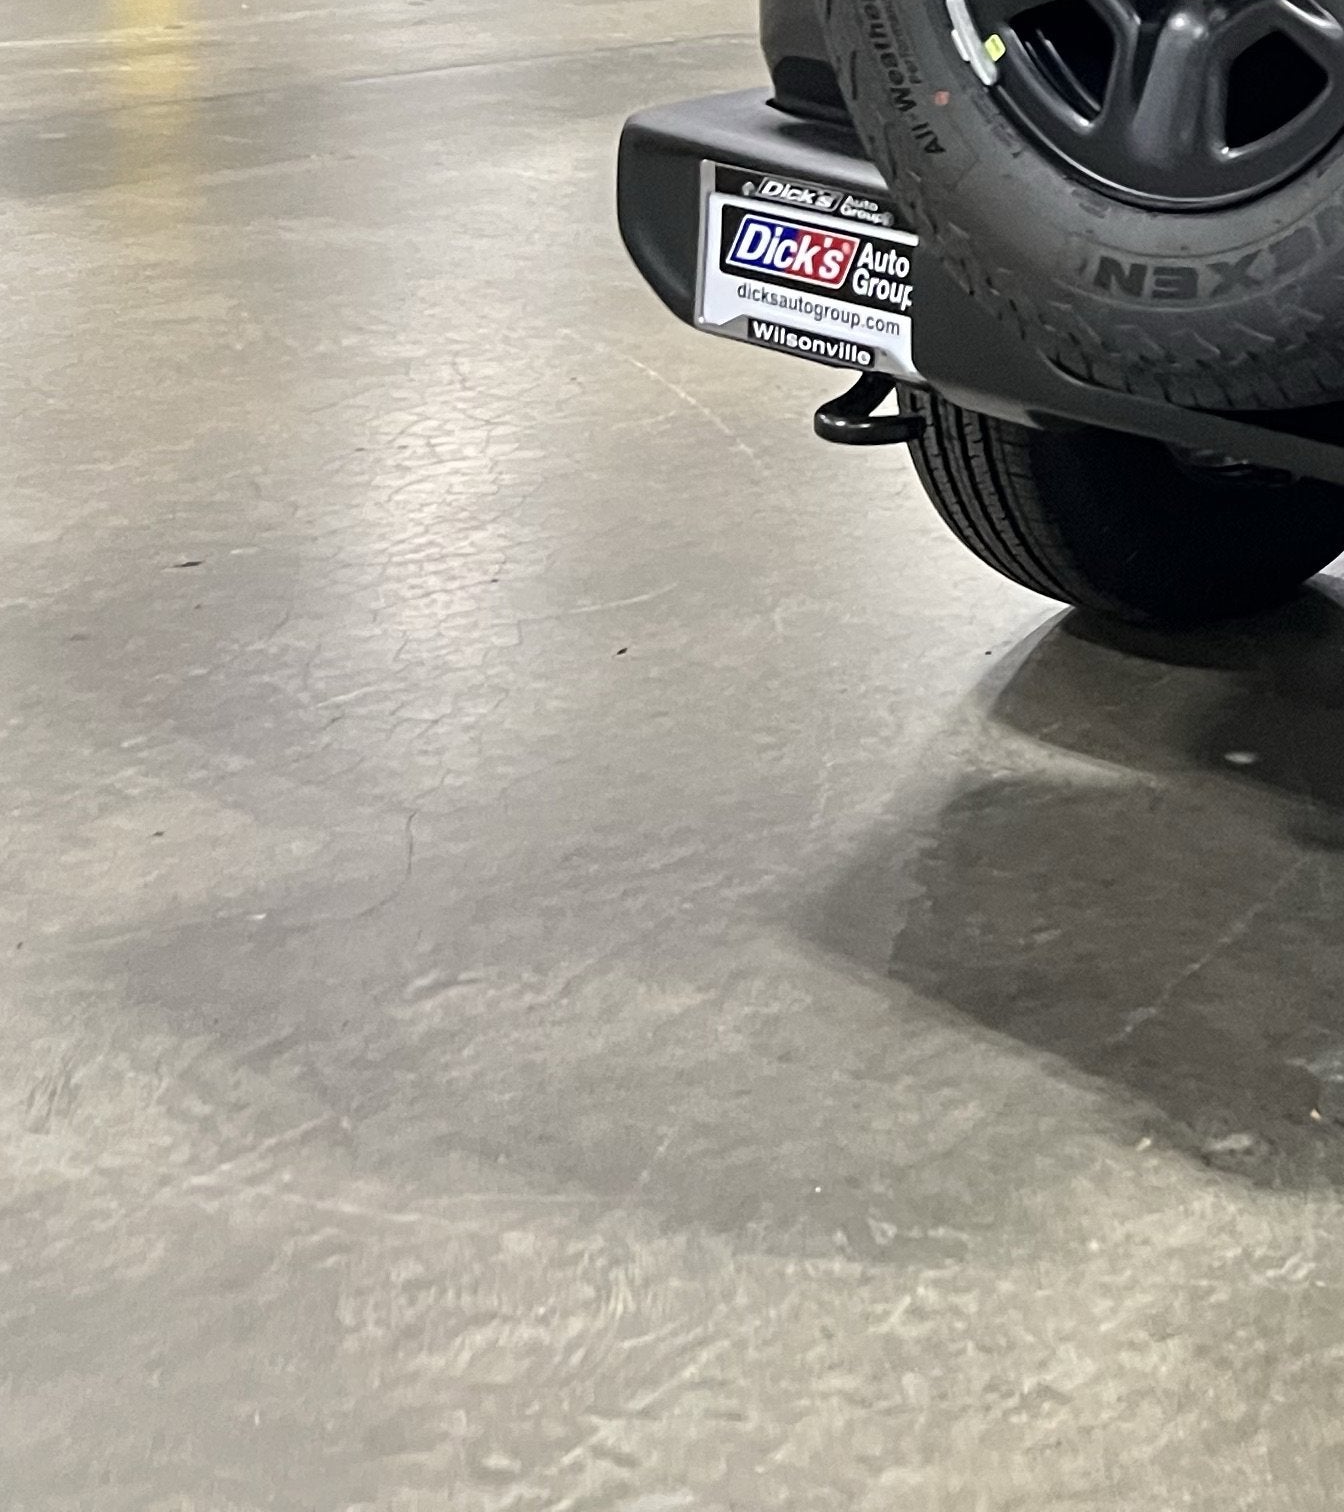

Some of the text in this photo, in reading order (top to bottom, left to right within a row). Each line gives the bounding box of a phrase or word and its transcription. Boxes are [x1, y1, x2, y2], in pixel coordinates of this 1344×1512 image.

[761, 179, 834, 208] Dick's
[843, 195, 878, 211] Auto
[840, 204, 889, 226] Group
[735, 222, 846, 280] Dick's
[856, 241, 910, 278] Auto
[736, 282, 901, 336] dicksautogroup.com
[752, 320, 872, 366] Wilsonville
